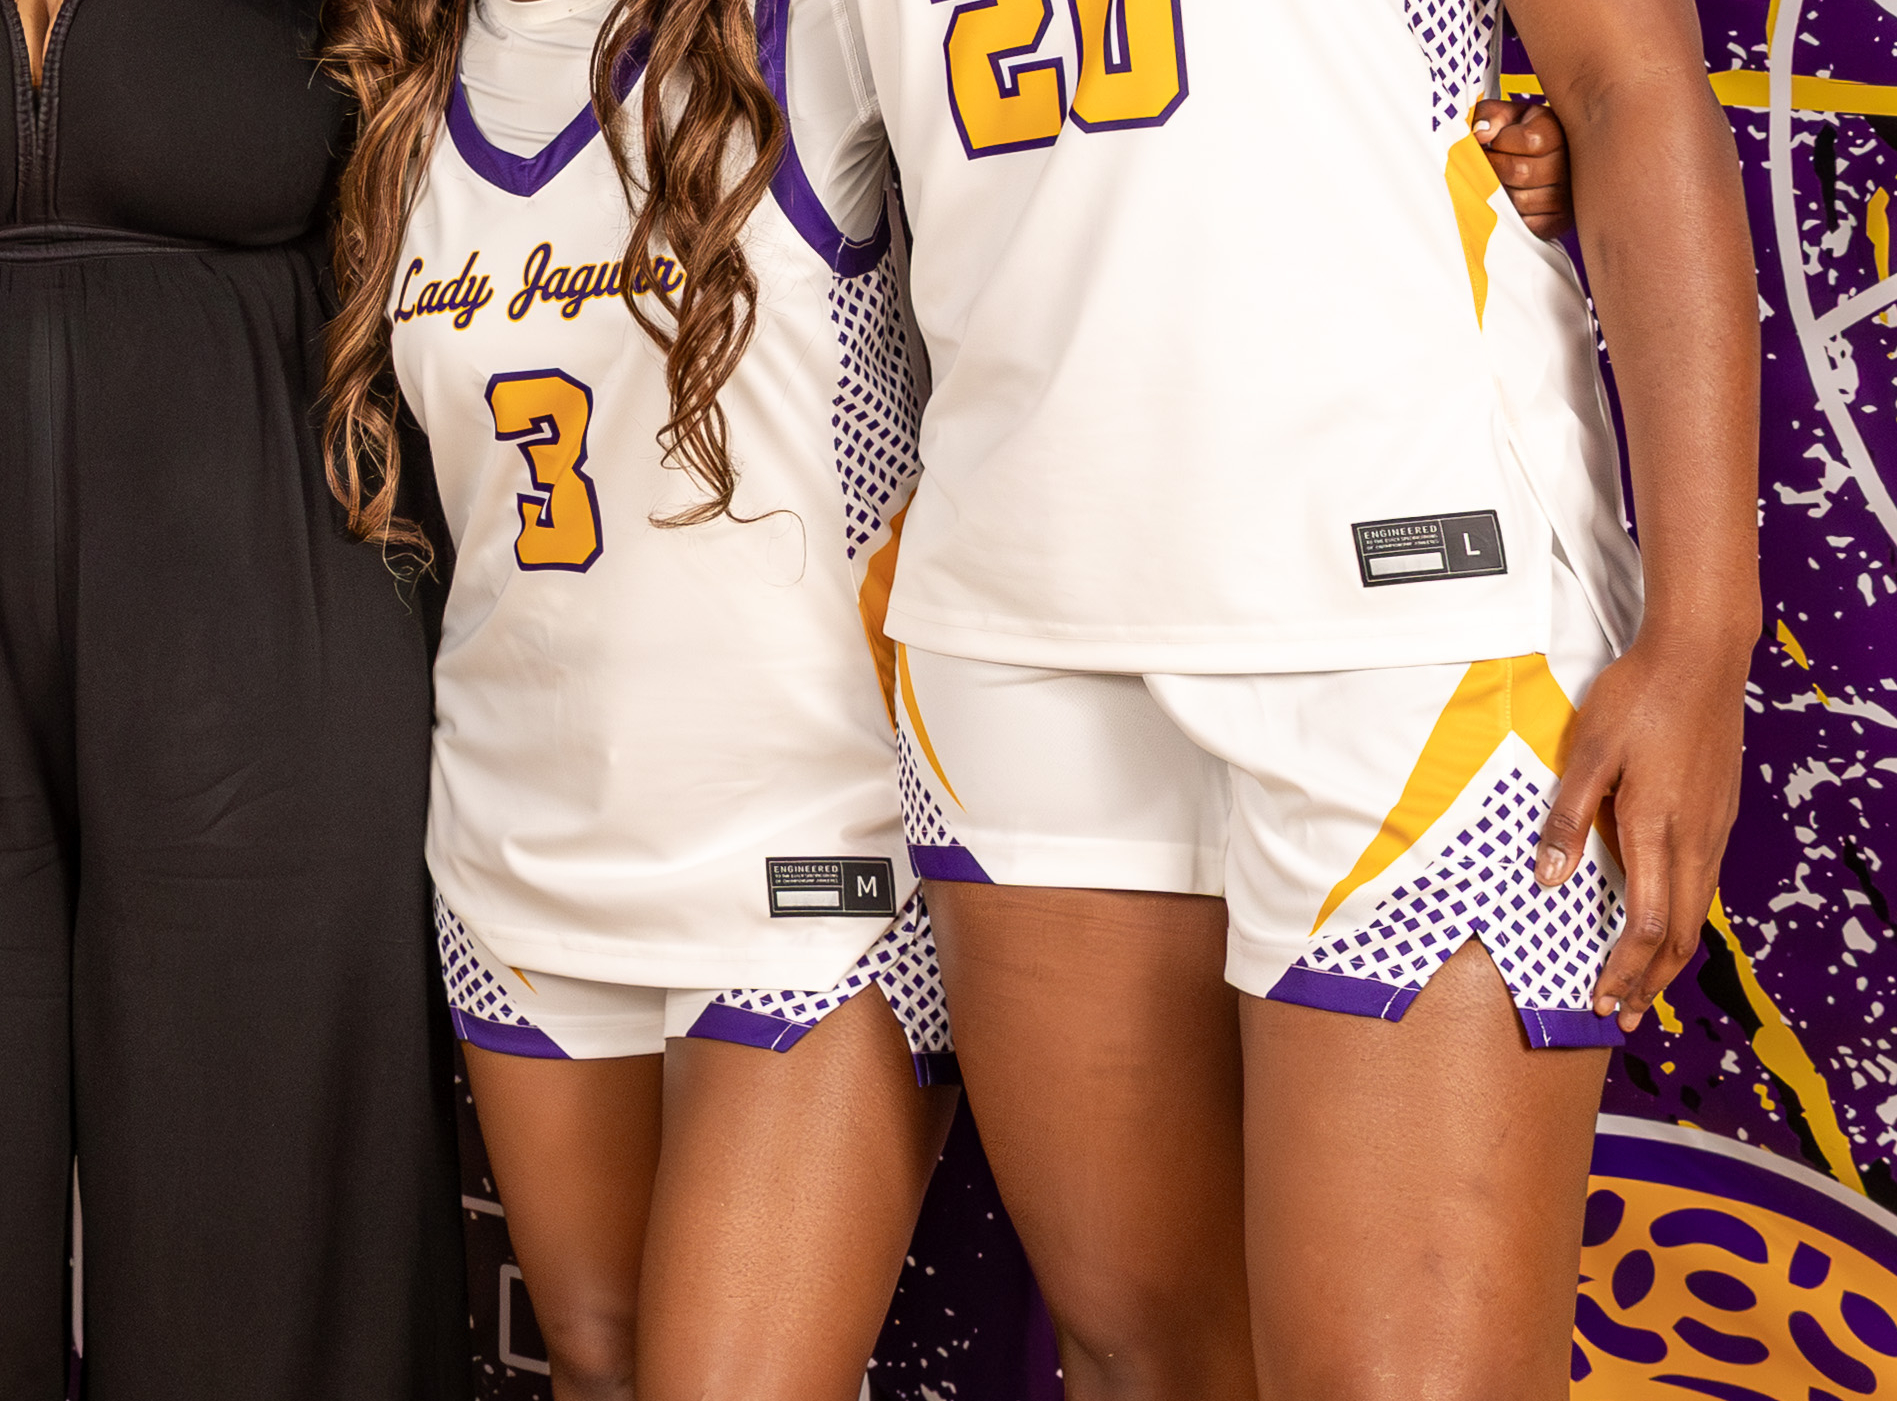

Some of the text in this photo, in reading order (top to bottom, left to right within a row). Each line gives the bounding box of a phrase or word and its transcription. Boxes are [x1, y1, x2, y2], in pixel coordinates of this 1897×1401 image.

[392, 250, 495, 332] Lady
[484, 367, 604, 574] 3
[1364, 525, 1438, 540] ENGINEERED
[1463, 532, 1481, 556] L
[773, 865, 839, 873] ENGINEERED
[856, 875, 878, 898] M
